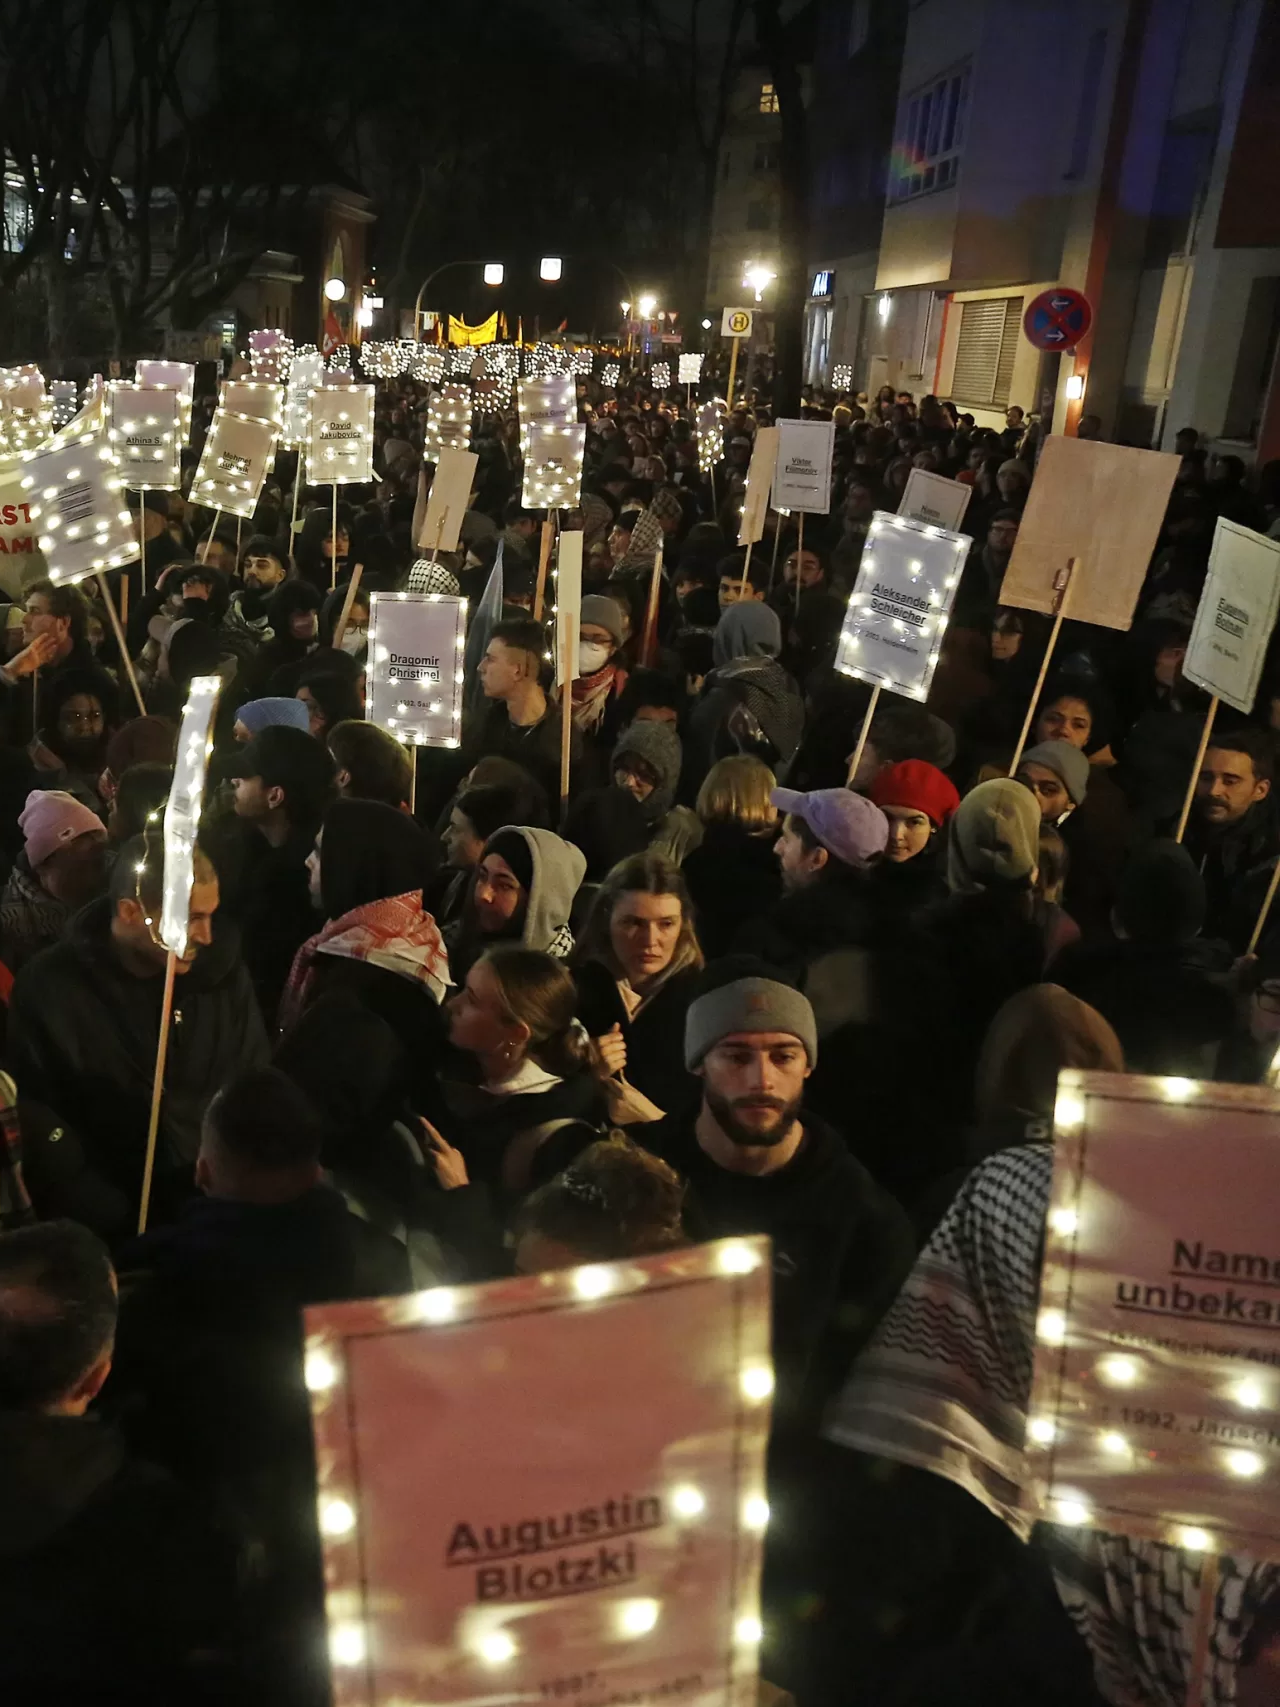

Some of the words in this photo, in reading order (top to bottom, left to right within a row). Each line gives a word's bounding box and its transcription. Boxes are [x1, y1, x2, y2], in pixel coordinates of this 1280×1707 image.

[330, 422, 351, 430] David
[126, 436, 152, 444] Athina
[872, 583, 932, 612] Aleksander
[870, 598, 927, 625] Schleicher
[390, 653, 440, 667] Dragomir
[388, 667, 440, 680] Christinel
[447, 1494, 663, 1558] Augustin
[476, 1540, 637, 1601] Blotzki
